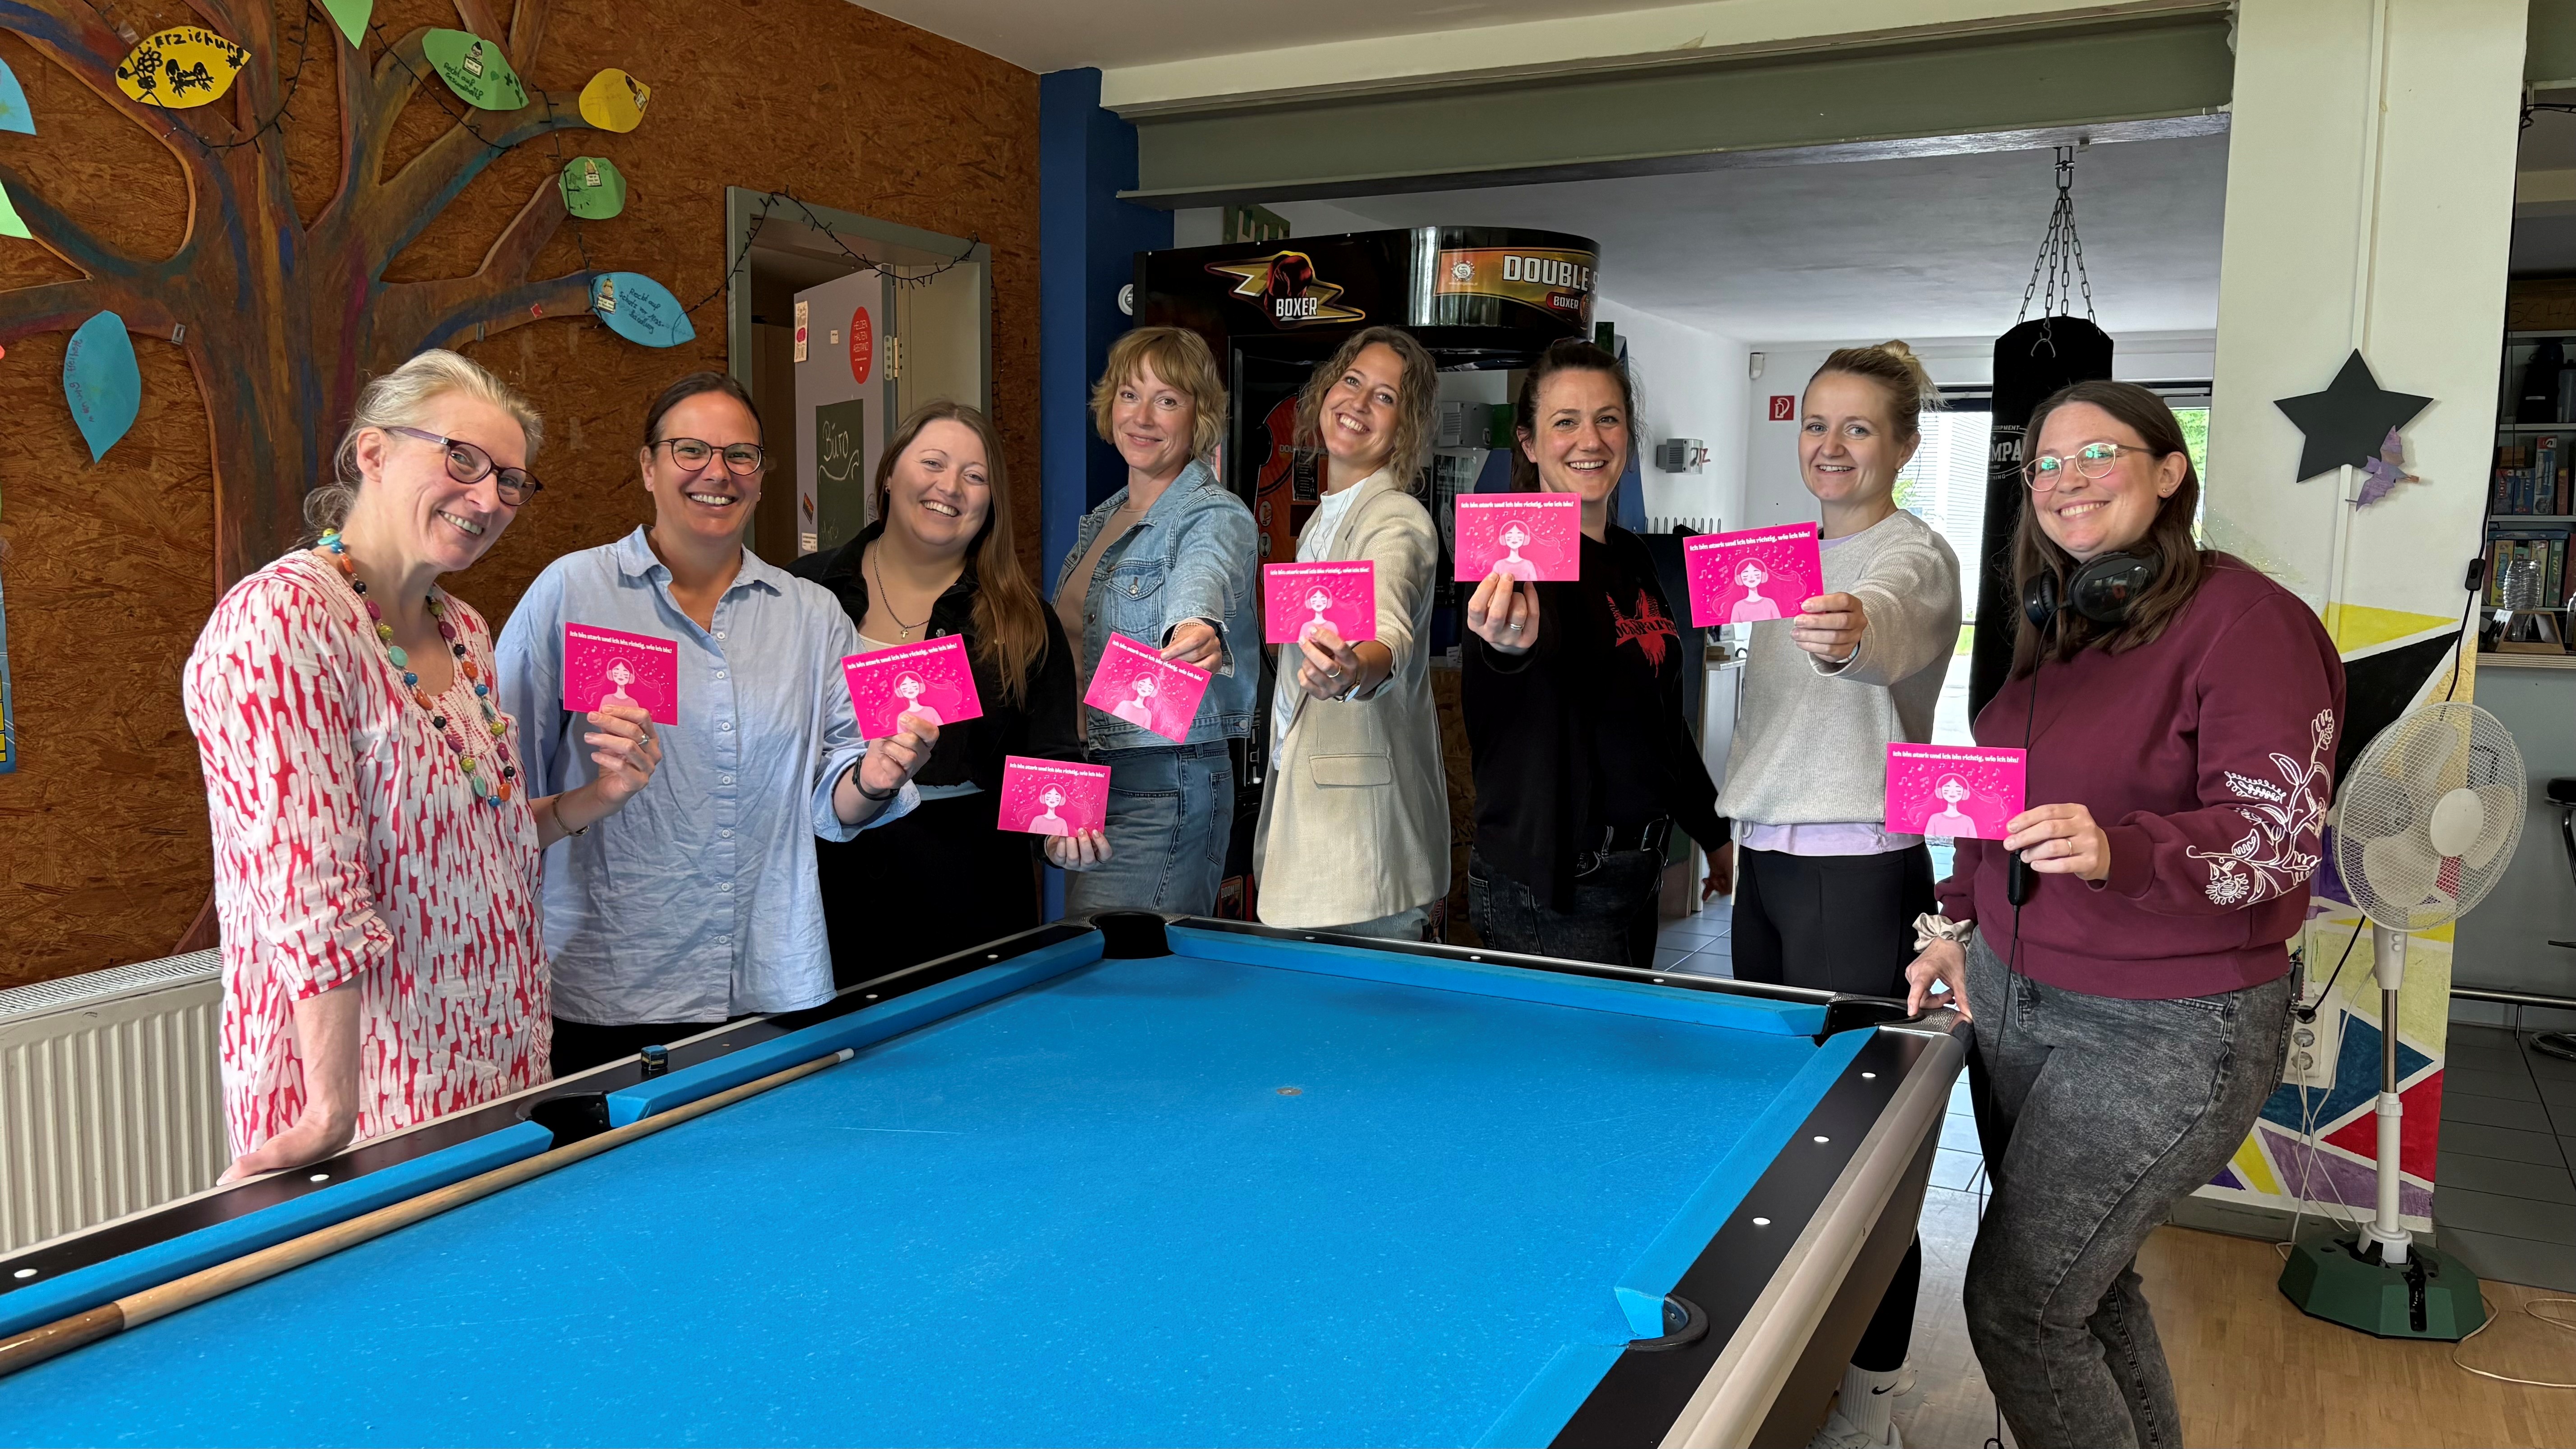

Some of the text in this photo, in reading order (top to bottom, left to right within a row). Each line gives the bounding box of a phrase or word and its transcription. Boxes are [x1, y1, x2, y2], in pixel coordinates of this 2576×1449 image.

[1503, 255, 1589, 292] DOUBLE
[1276, 297, 1318, 317] BOXER
[1553, 295, 1579, 310] BOXER
[823, 420, 849, 462] Büro
[1756, 535, 1777, 543] richtig,
[628, 640, 645, 649] richtig,
[908, 649, 928, 657] richtig,
[1962, 754, 1984, 762] richtig,
